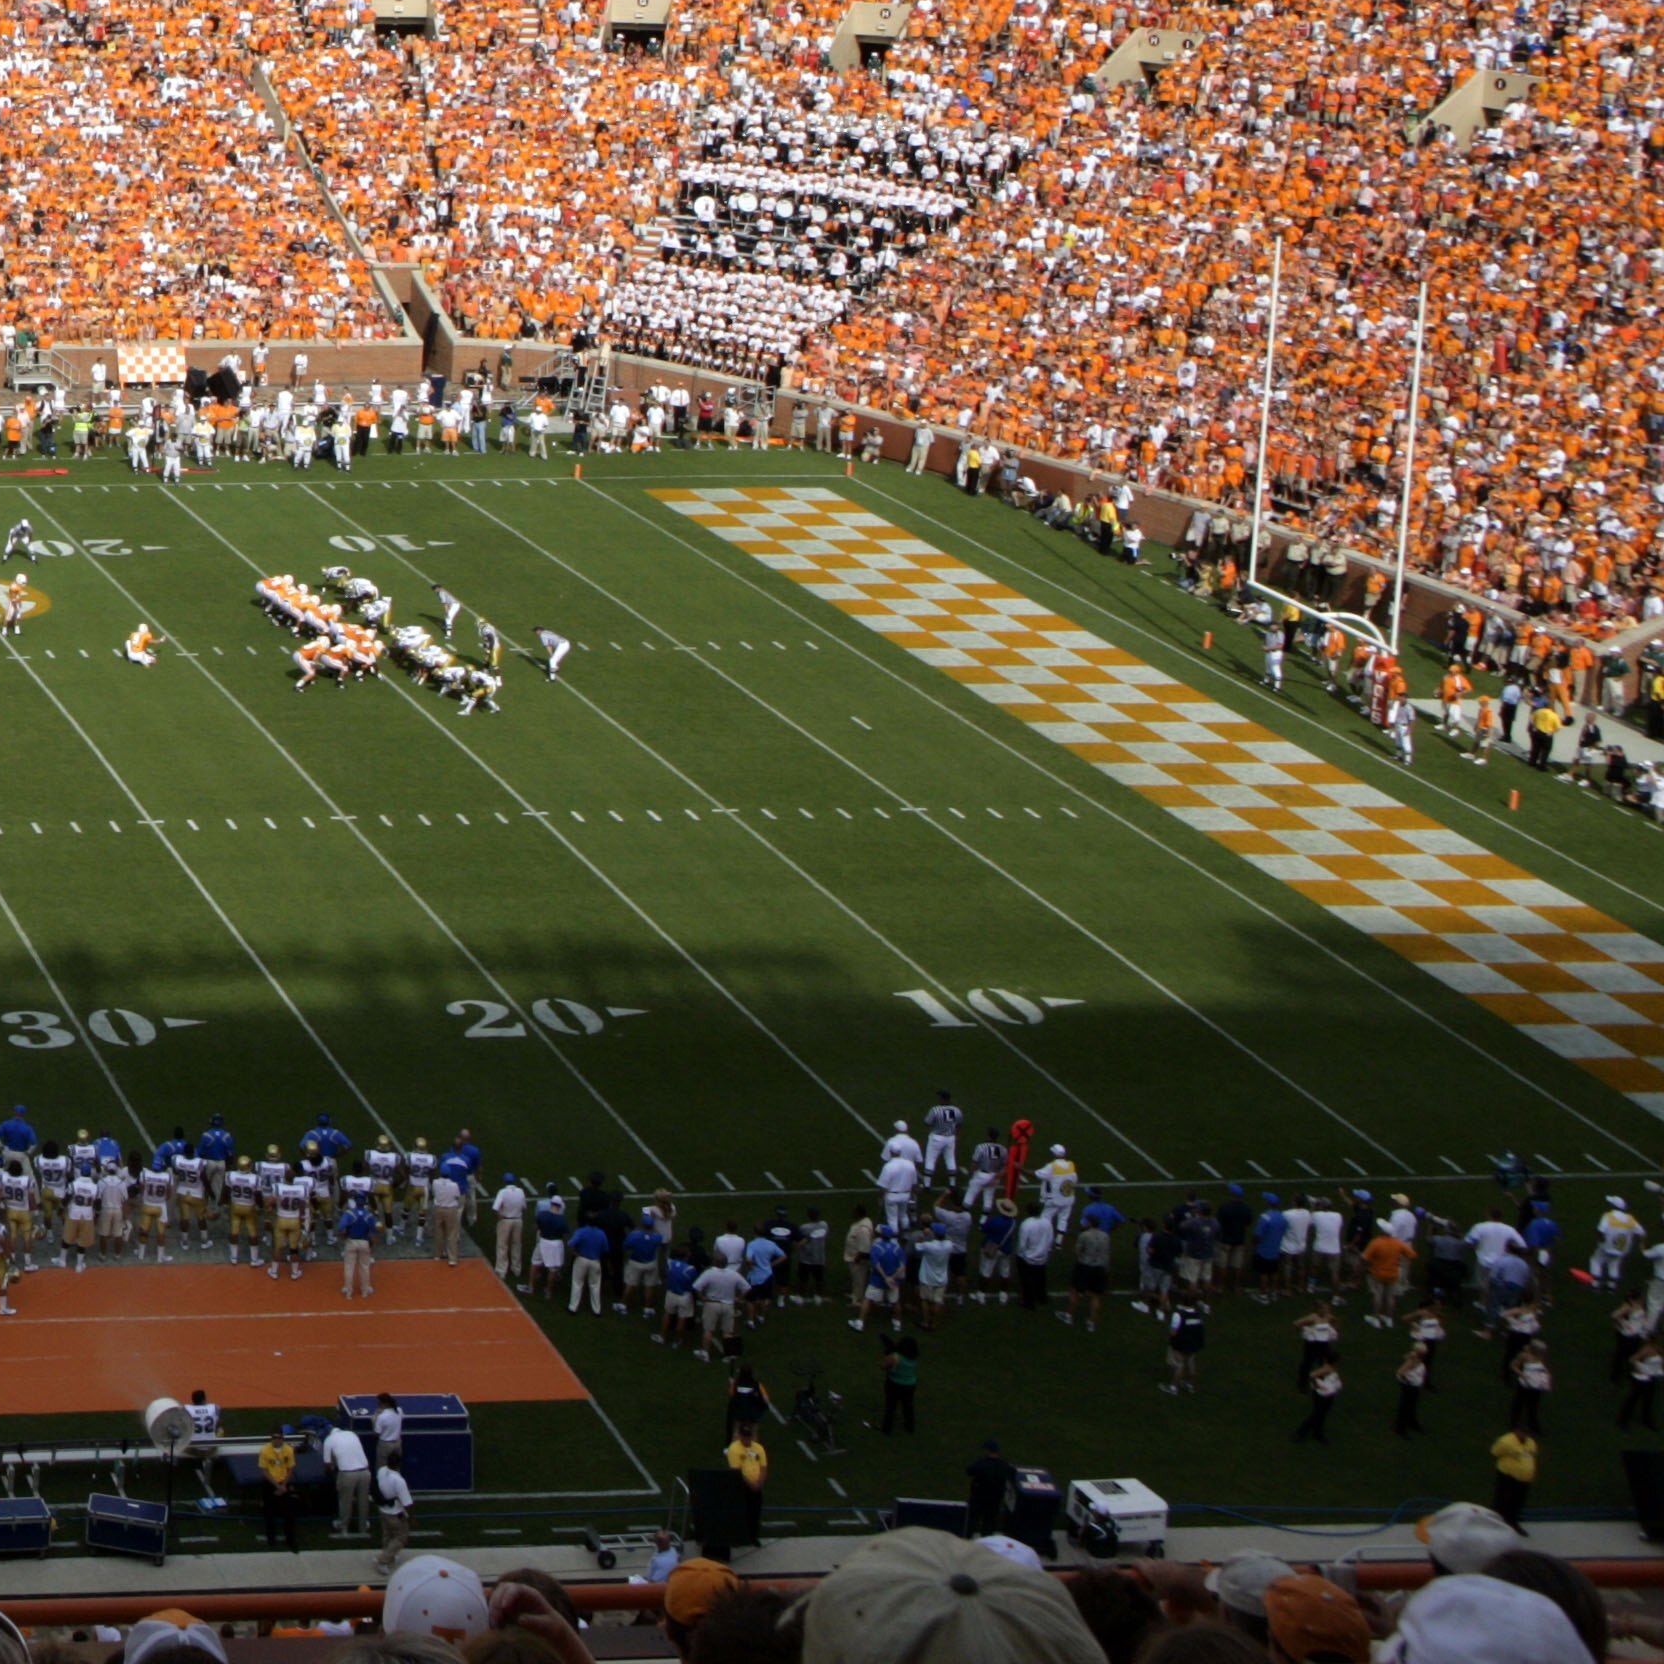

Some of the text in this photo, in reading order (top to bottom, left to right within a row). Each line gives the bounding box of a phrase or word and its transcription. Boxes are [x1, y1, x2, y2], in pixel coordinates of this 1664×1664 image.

[445, 998, 604, 1038] 20
[893, 987, 1043, 1027] 10
[0, 1009, 156, 1048] 30
